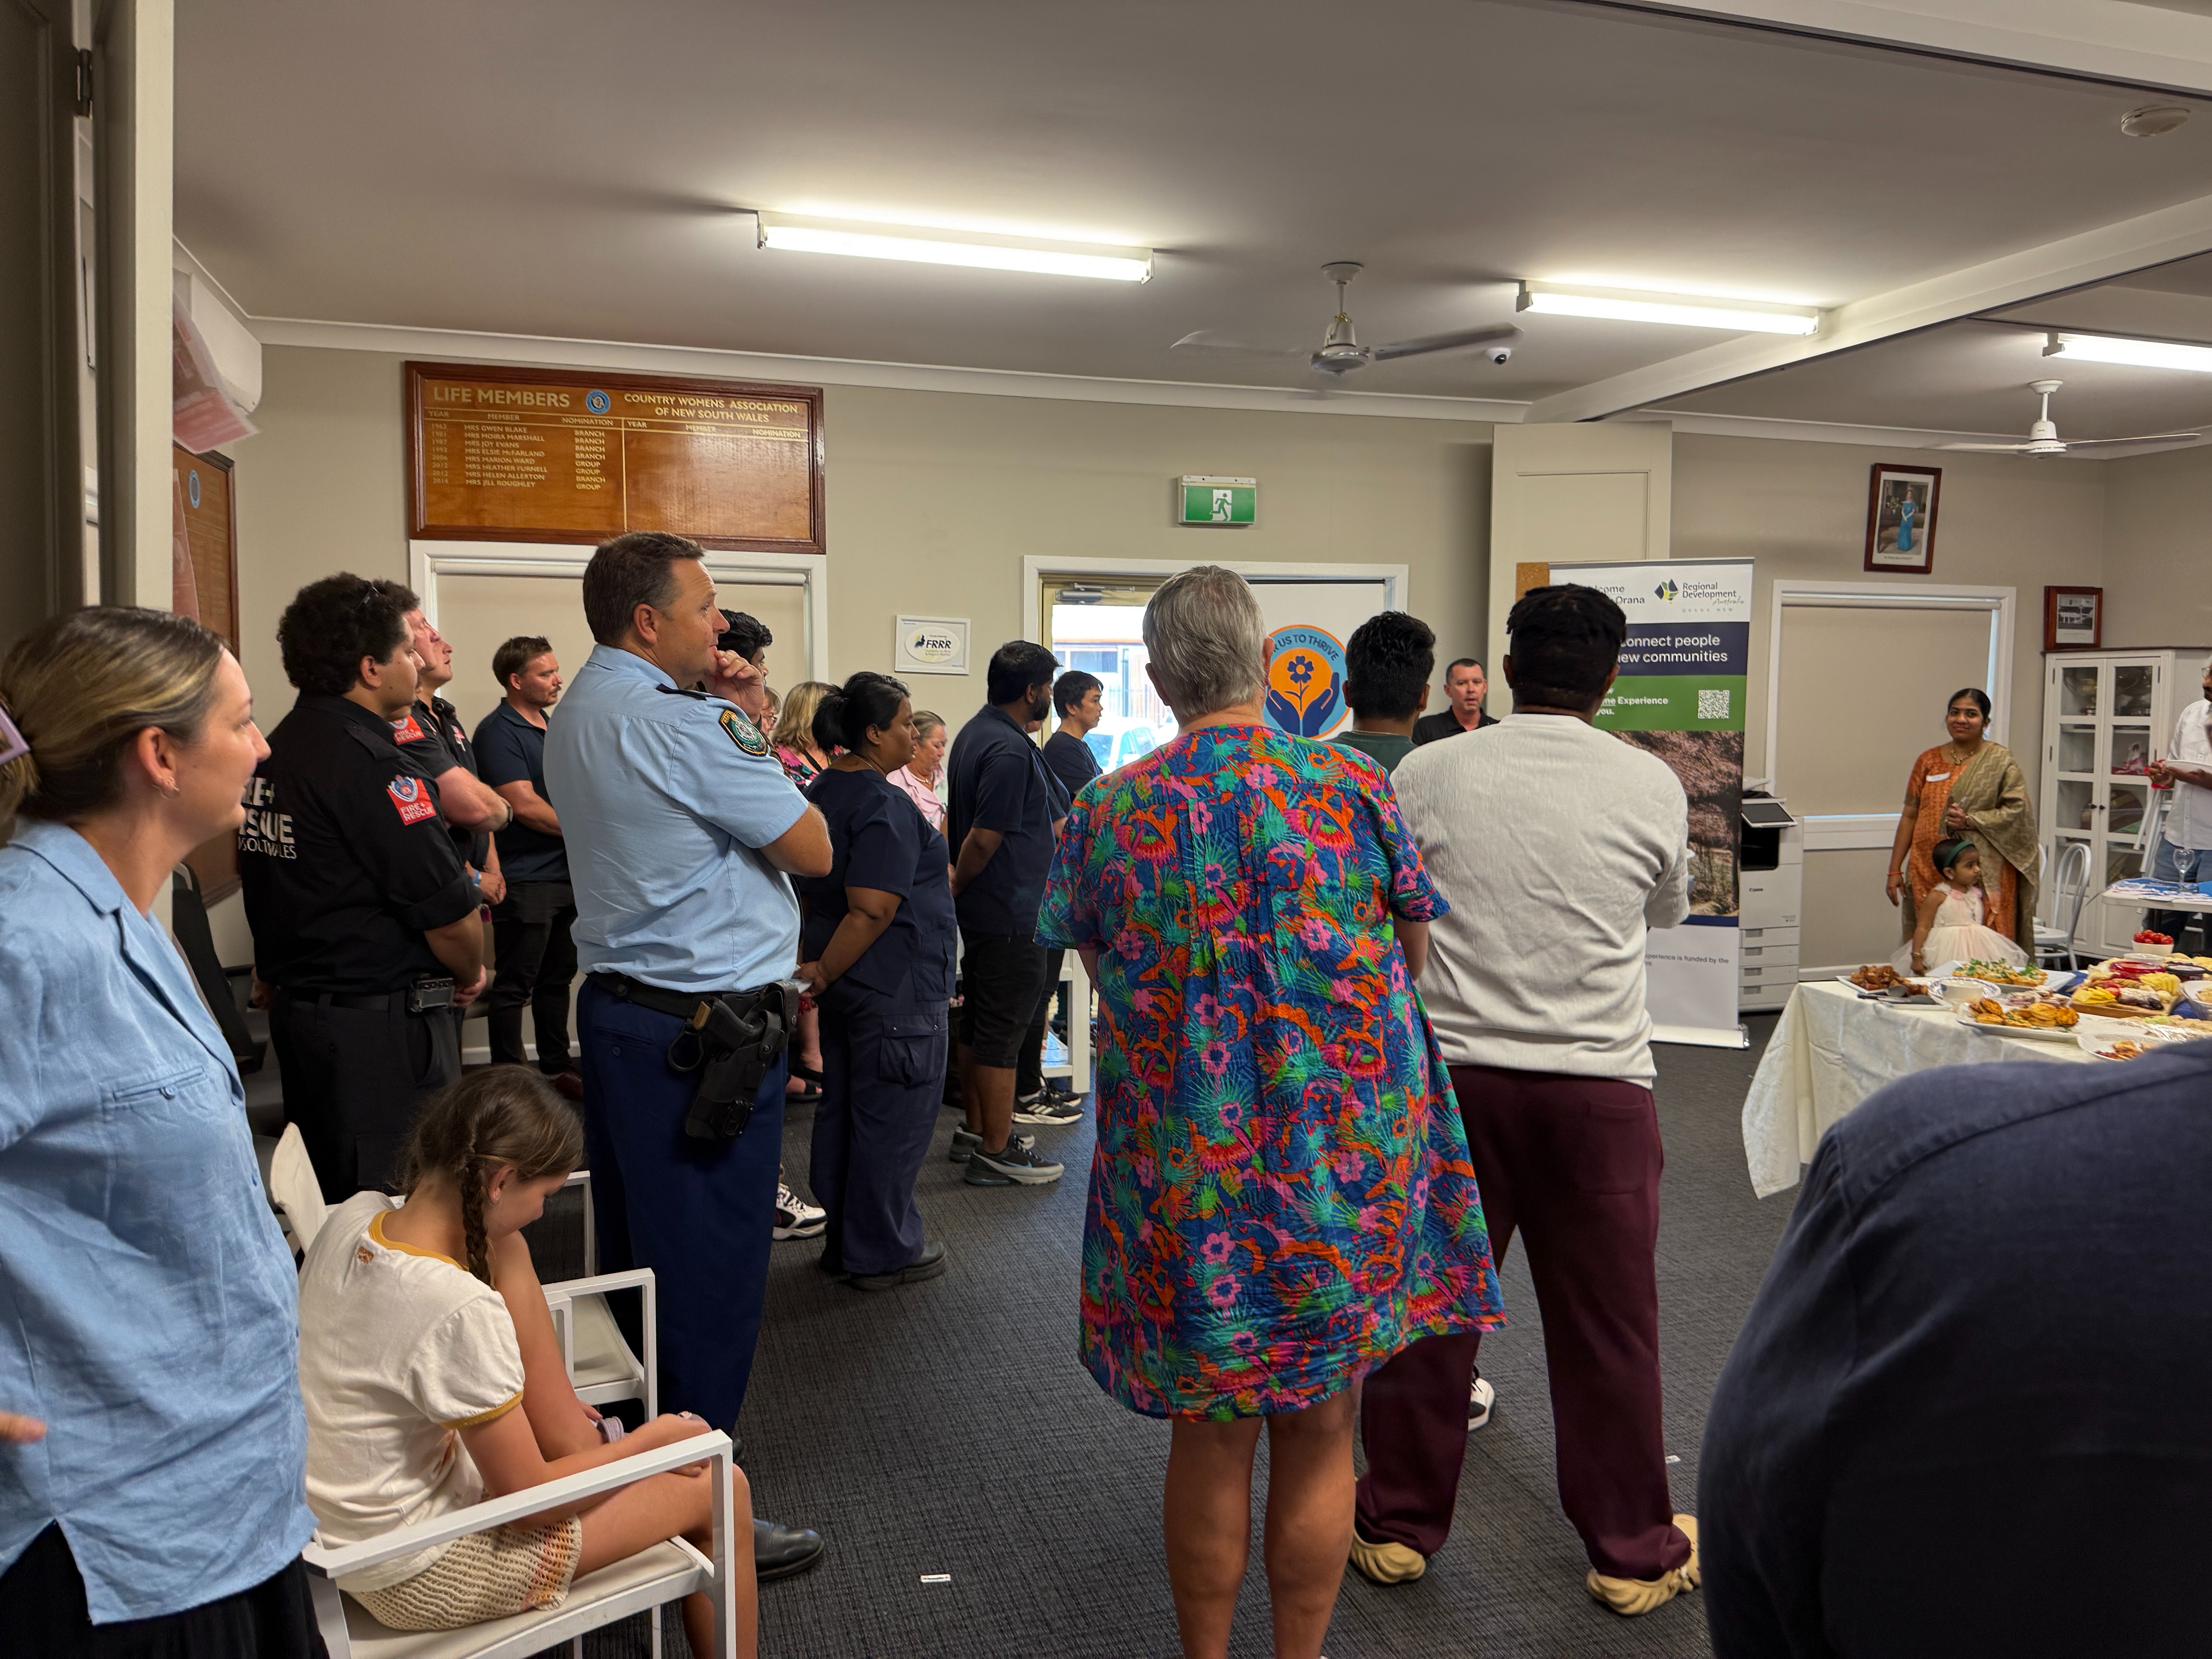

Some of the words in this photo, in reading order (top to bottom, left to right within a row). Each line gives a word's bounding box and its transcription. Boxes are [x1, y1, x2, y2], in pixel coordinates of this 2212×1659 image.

[433, 387, 472, 402] LIFE
[477, 388, 570, 407] MEMBERS
[624, 393, 675, 405] COUNTRY
[678, 397, 725, 408] WOMENS
[730, 400, 798, 413] ASSOCIATION
[655, 407, 669, 416] OF
[672, 409, 696, 418] NEW
[698, 410, 733, 420] SOUTH
[736, 413, 769, 422] WALES
[562, 417, 613, 426] NOMINATION
[685, 424, 716, 433] MEMBER
[752, 428, 801, 438] NOMINATION
[1683, 582, 1717, 592] Regional
[1682, 590, 1736, 600] Development
[1713, 596, 1744, 605] Australia
[926, 639, 951, 649] FRRR
[1278, 636, 1292, 647] US
[1293, 634, 1307, 643] TO
[1308, 635, 1340, 661] THRIVE
[1675, 634, 1720, 648] people
[1643, 650, 1728, 663] communities
[1617, 696, 1668, 706] Experience
